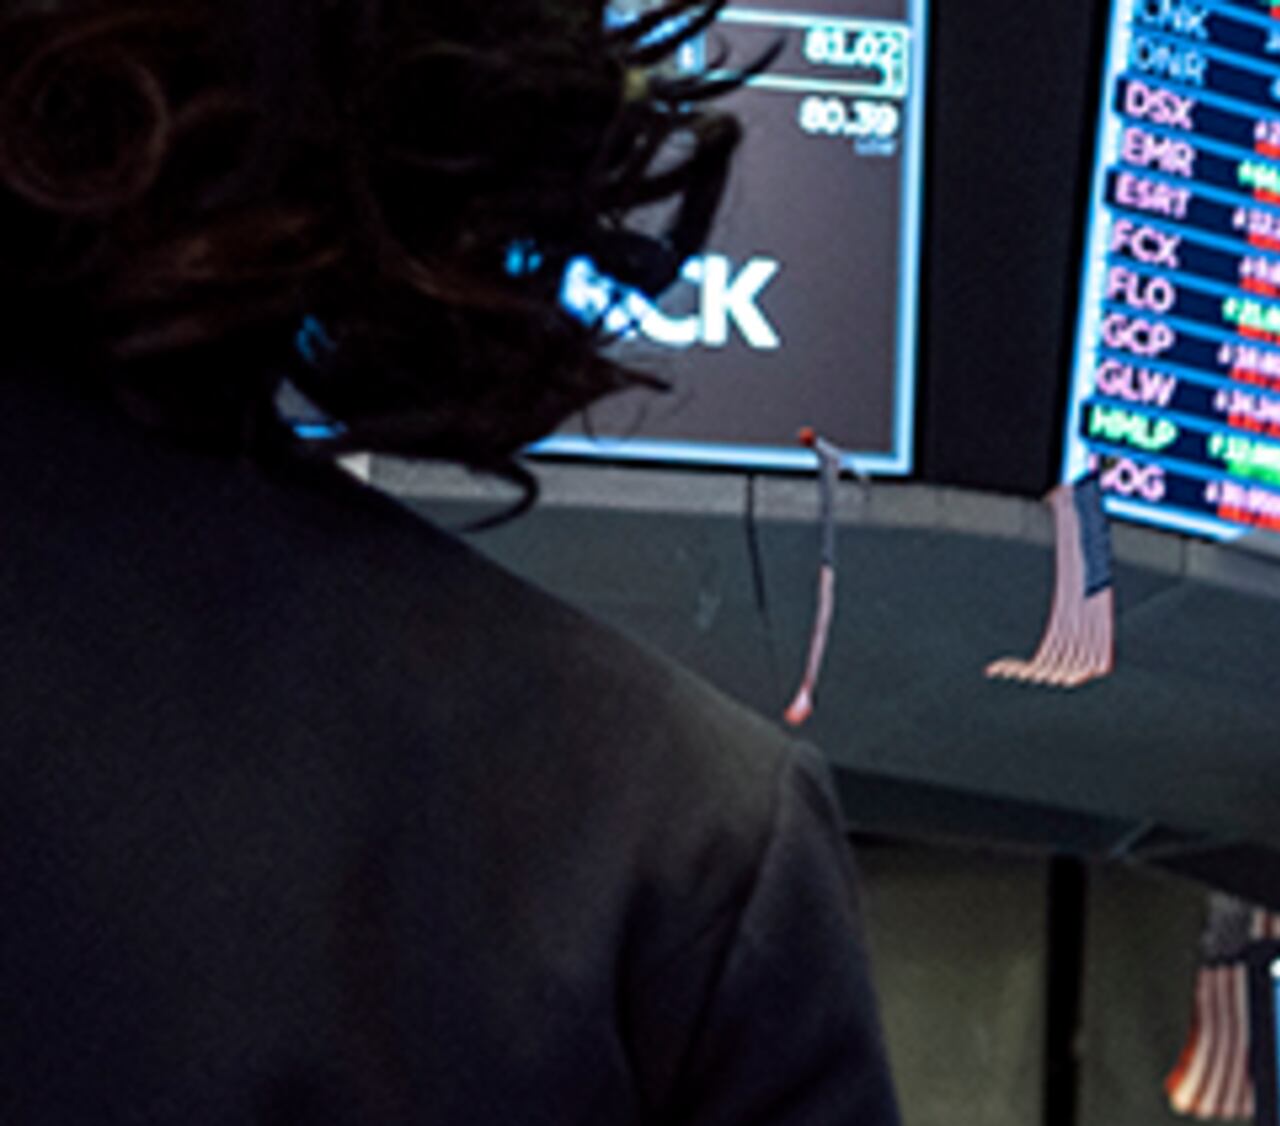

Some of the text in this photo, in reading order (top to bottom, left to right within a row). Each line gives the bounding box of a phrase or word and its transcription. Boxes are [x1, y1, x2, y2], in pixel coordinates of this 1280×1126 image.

[1125, 79, 1193, 129] DSX
[1121, 126, 1195, 177] EMR
[1110, 218, 1181, 268] FCX
[1107, 264, 1175, 312] FLO
[1104, 312, 1174, 355] GCP
[1098, 358, 1176, 407] GLW
